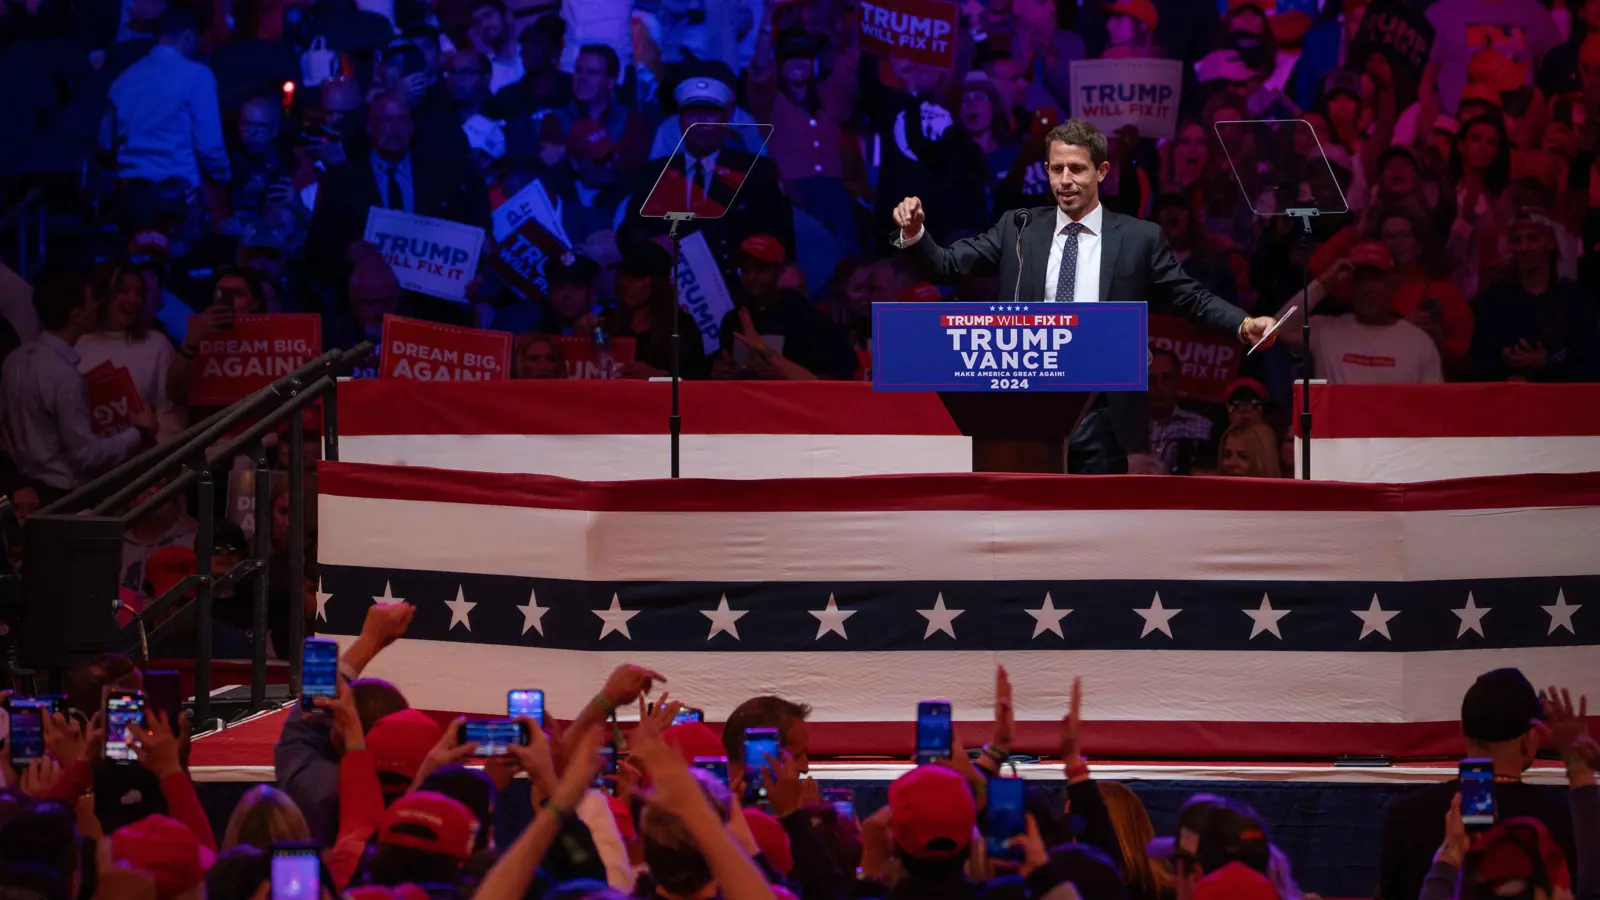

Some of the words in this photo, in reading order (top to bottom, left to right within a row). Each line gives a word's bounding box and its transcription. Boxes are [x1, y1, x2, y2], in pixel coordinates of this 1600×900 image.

[859, 1, 952, 39] TRUMP
[860, 21, 895, 45] WILL
[898, 33, 927, 50] FIX
[931, 39, 949, 53] IT
[1081, 85, 1173, 104] TRUMP
[1082, 105, 1124, 118] WILL
[1129, 104, 1153, 117] FIX
[1157, 104, 1170, 118] IT
[375, 232, 469, 267] TRUMP
[417, 260, 443, 277] FIX
[448, 268, 464, 281] IT
[946, 316, 994, 326] TRUMP
[997, 316, 1030, 326] WILL
[1034, 316, 1057, 326] FIX
[1060, 316, 1073, 326] IT
[198, 339, 269, 355] DREAM
[273, 339, 312, 357] BIG,
[946, 328, 1073, 351] TRUMP
[392, 340, 459, 364] DREAM
[462, 352, 501, 373] BIG,
[960, 351, 1059, 370] VANCE
[1181, 362, 1209, 380] FIX
[1213, 366, 1229, 381] IT
[990, 379, 1030, 390] 2024
